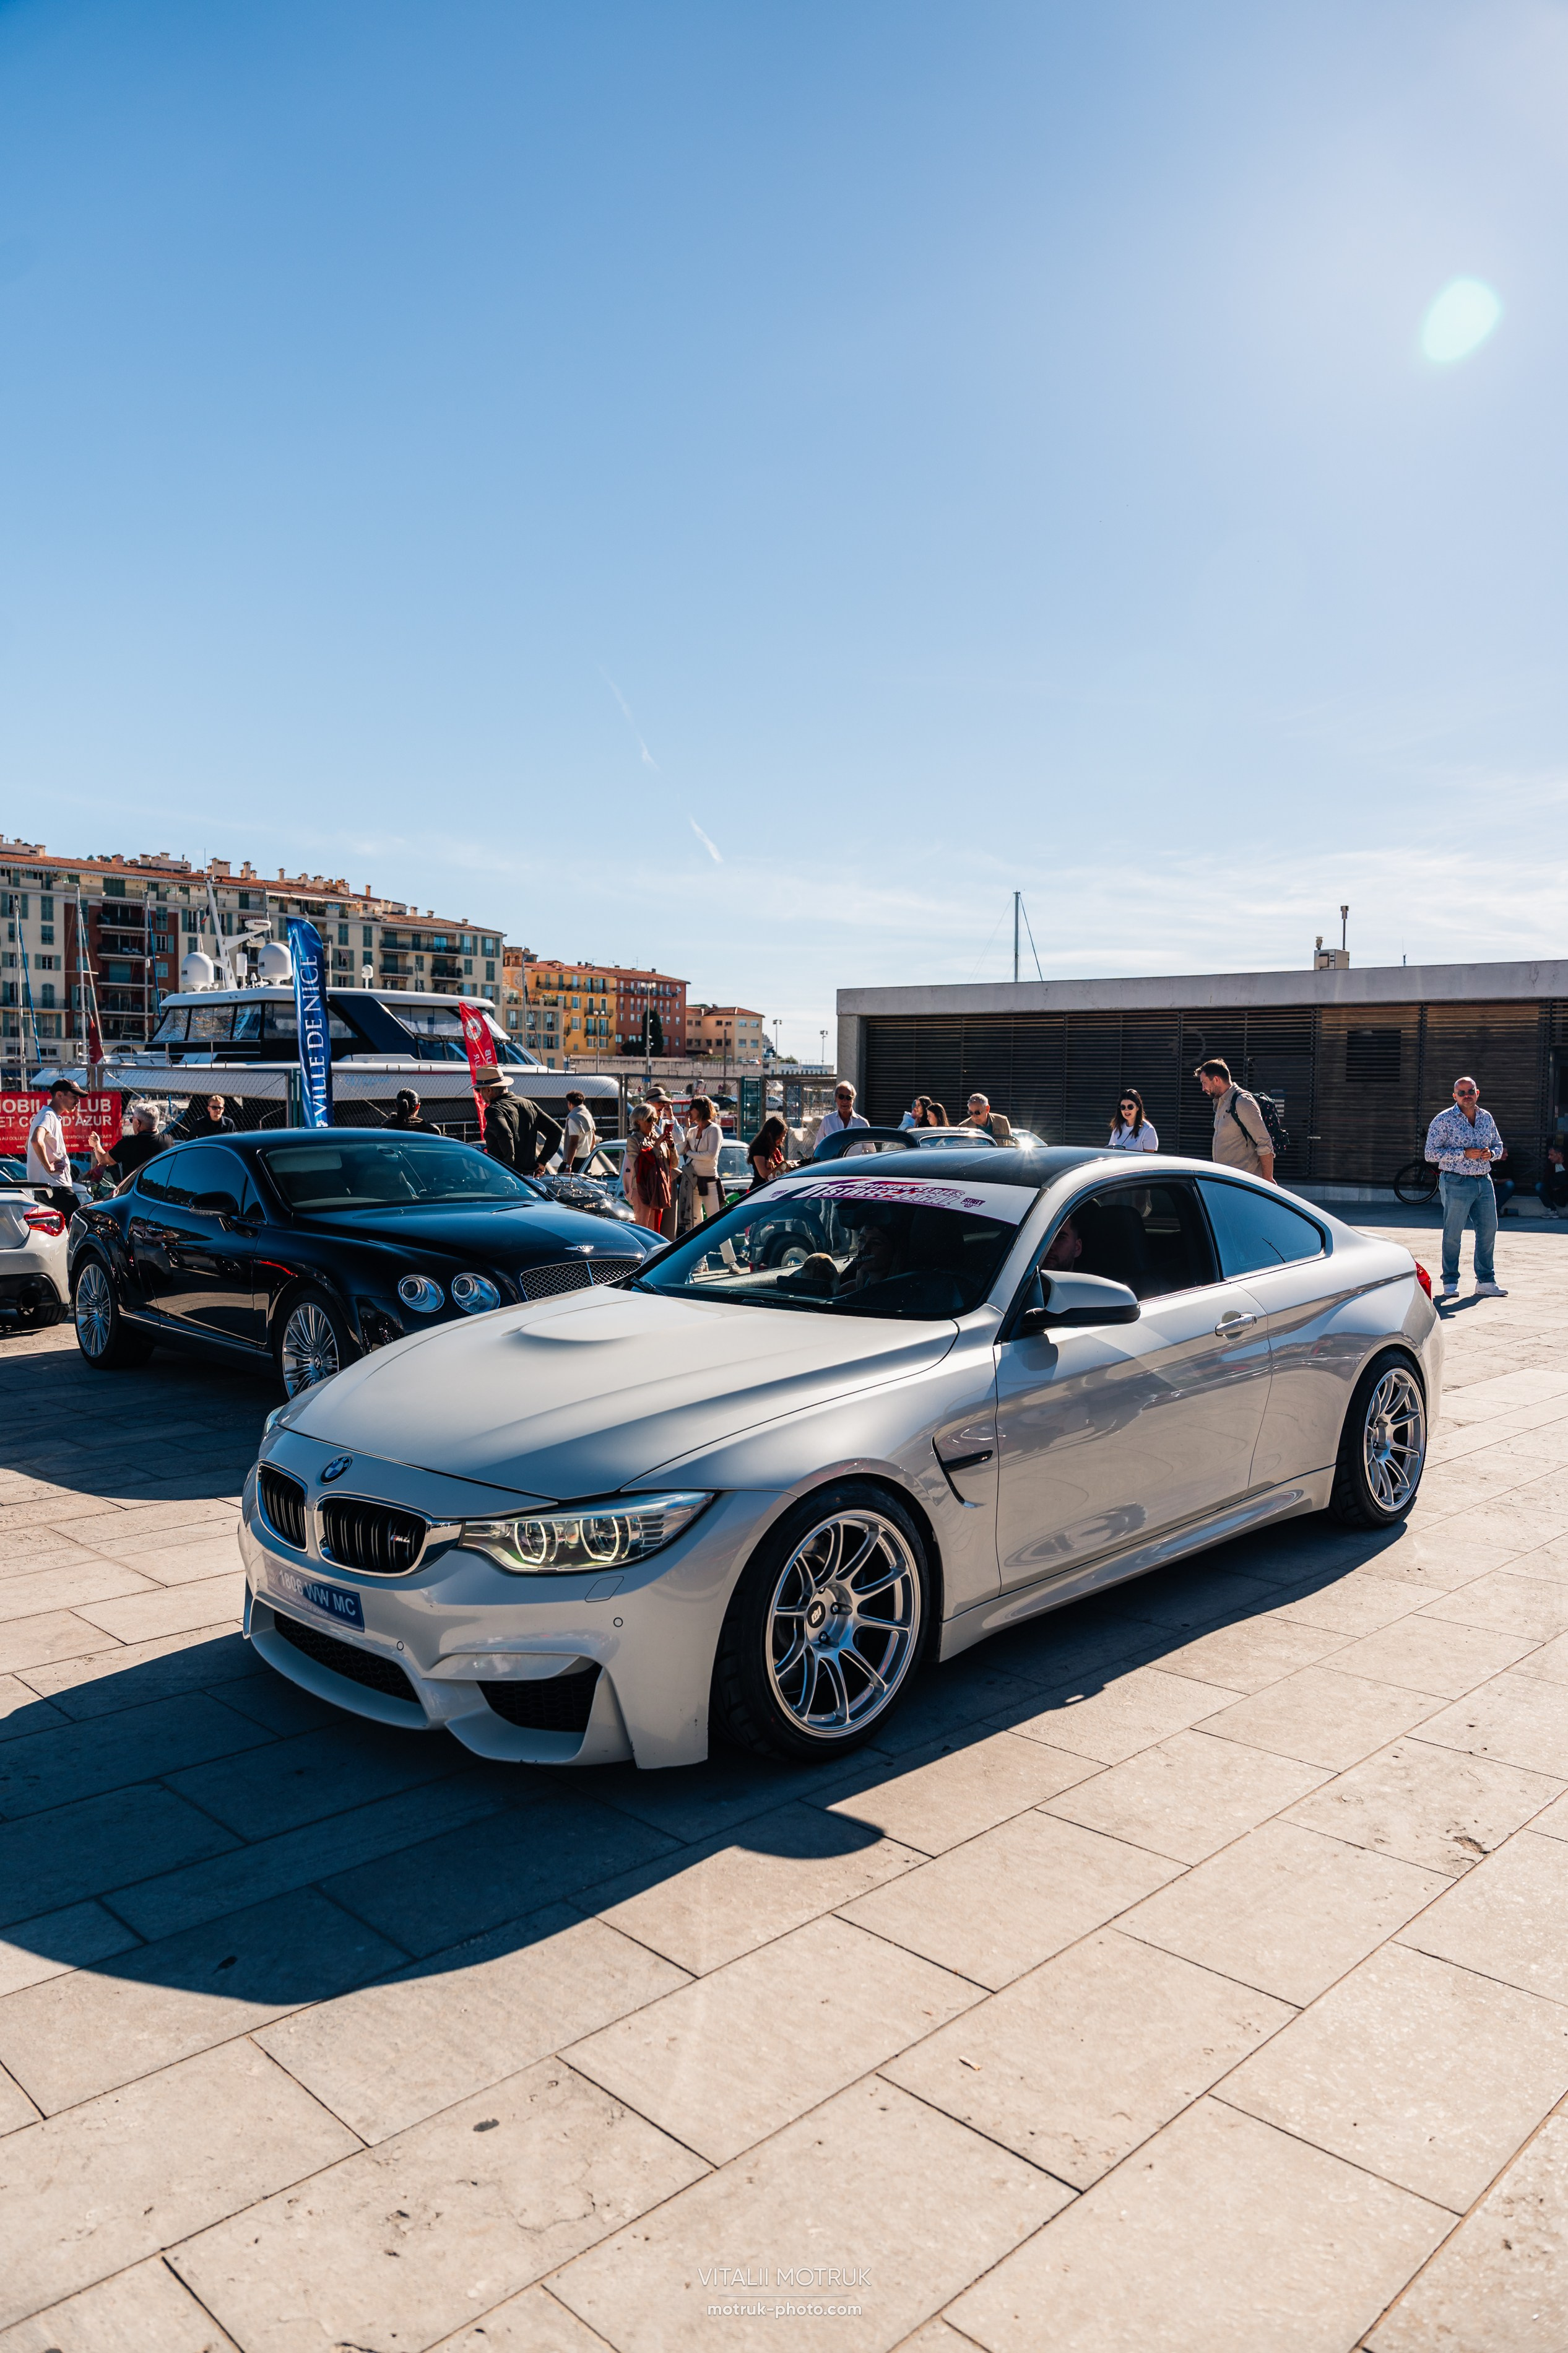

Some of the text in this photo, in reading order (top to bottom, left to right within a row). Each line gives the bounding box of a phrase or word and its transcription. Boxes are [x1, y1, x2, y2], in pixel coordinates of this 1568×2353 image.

[299, 955, 327, 1116] VILLE DE NICE
[77, 1098, 111, 1113] LUB
[63, 1116, 112, 1126] D'AZUR
[914, 1187, 966, 1196] SERIES
[279, 1570, 356, 1616] 1806 WW MC
